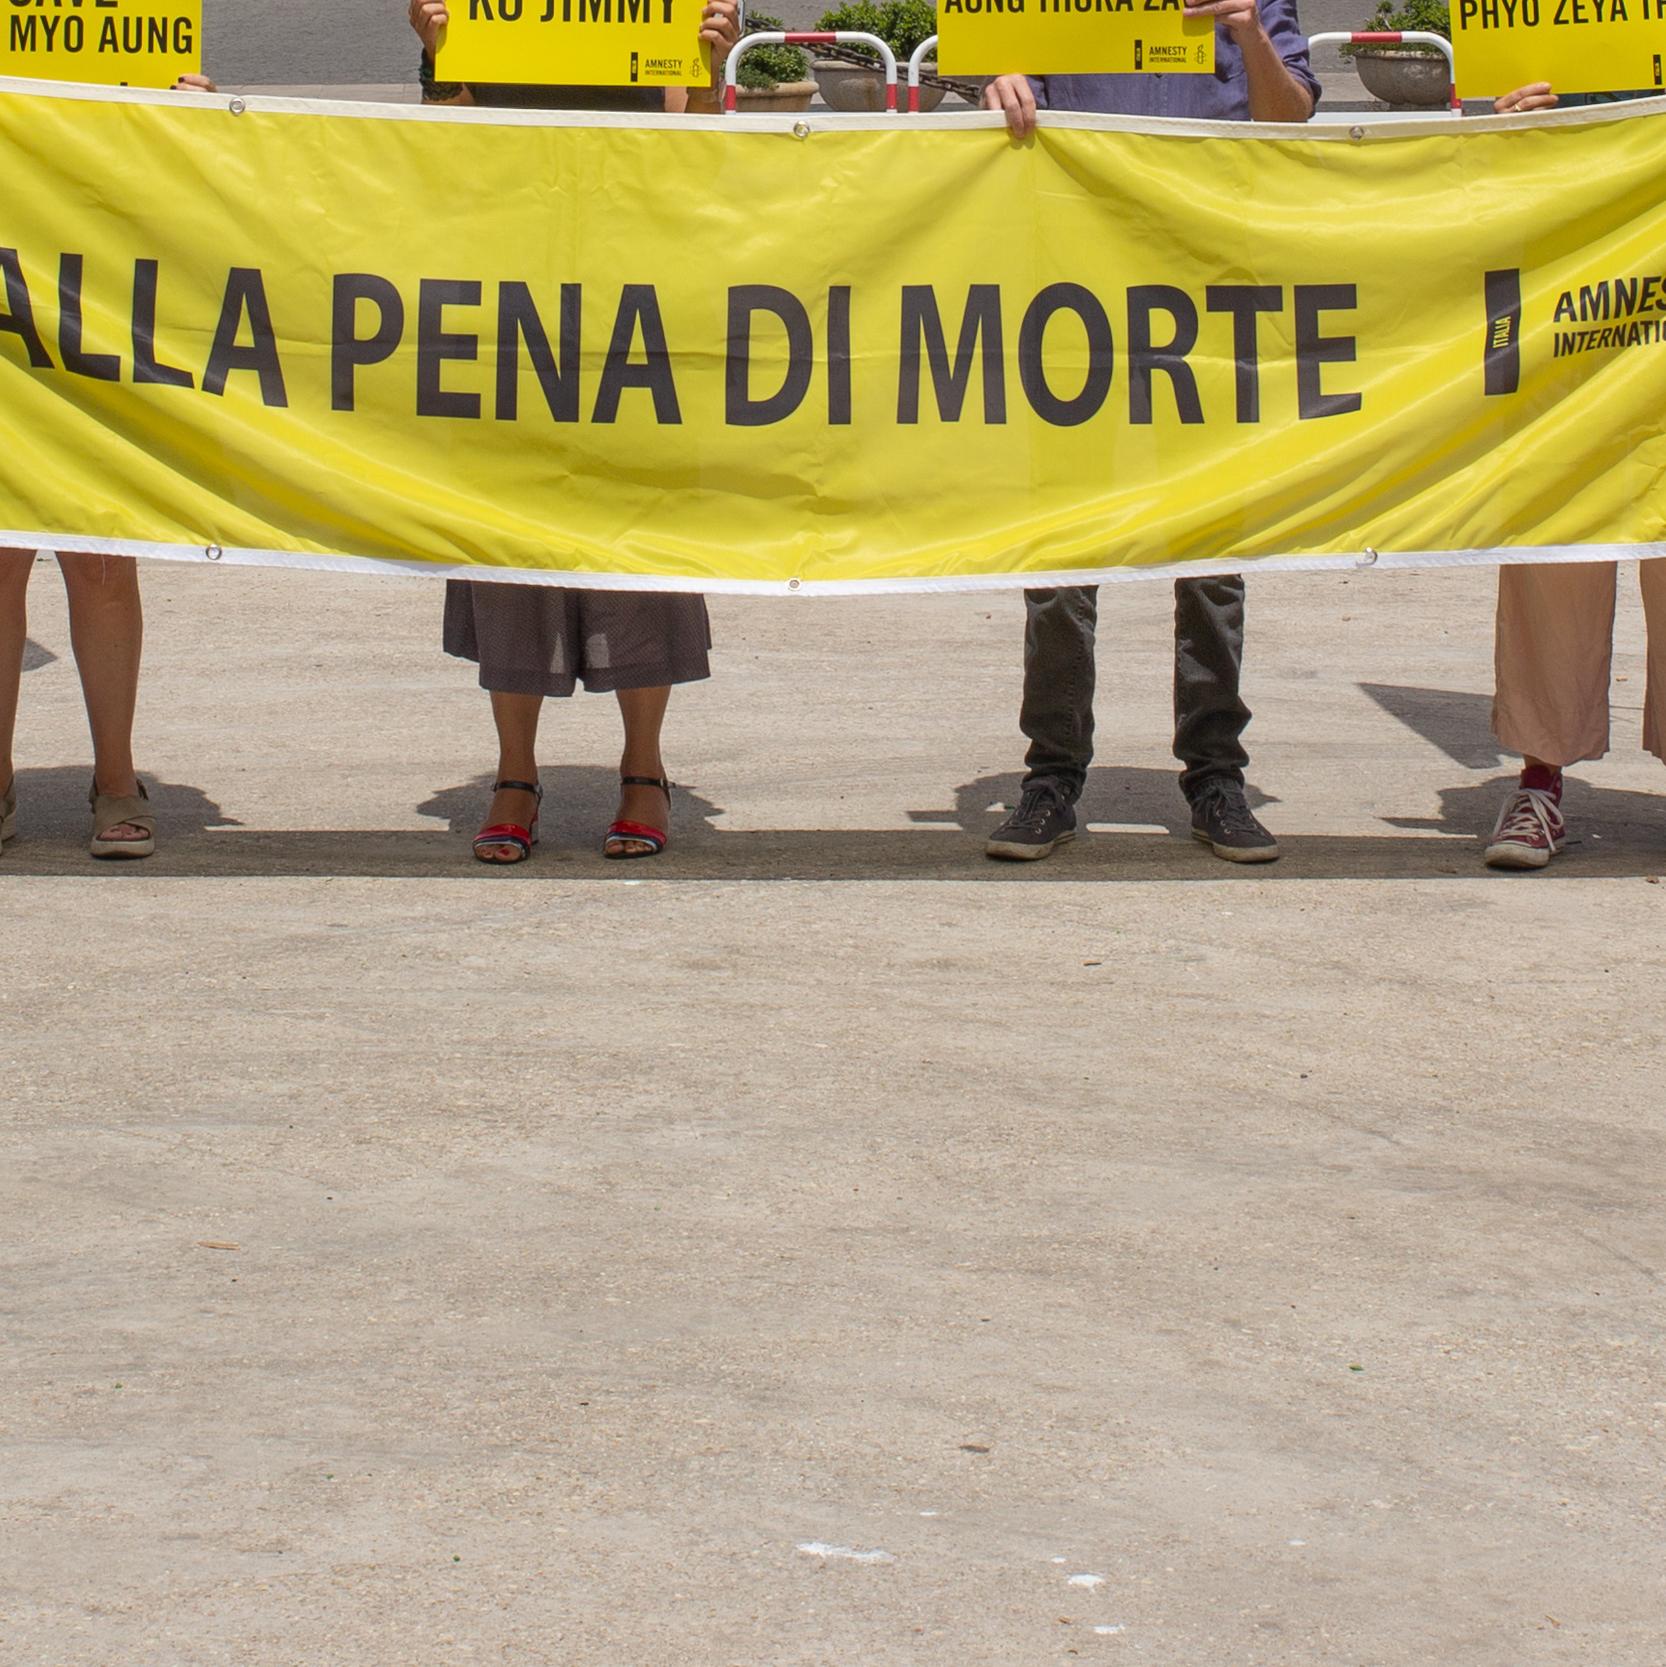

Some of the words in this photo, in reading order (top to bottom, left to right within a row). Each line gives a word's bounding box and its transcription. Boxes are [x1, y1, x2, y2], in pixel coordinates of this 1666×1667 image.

[10, 15, 83, 53] MYO
[98, 16, 193, 54] AUNG
[1149, 46, 1187, 55] AMNESTY
[645, 59, 683, 68] AMNESTY
[1493, 316, 1511, 349] ITALIA
[331, 273, 684, 425] PENA
[725, 284, 851, 426] DI
[896, 282, 1363, 426] MORTE
